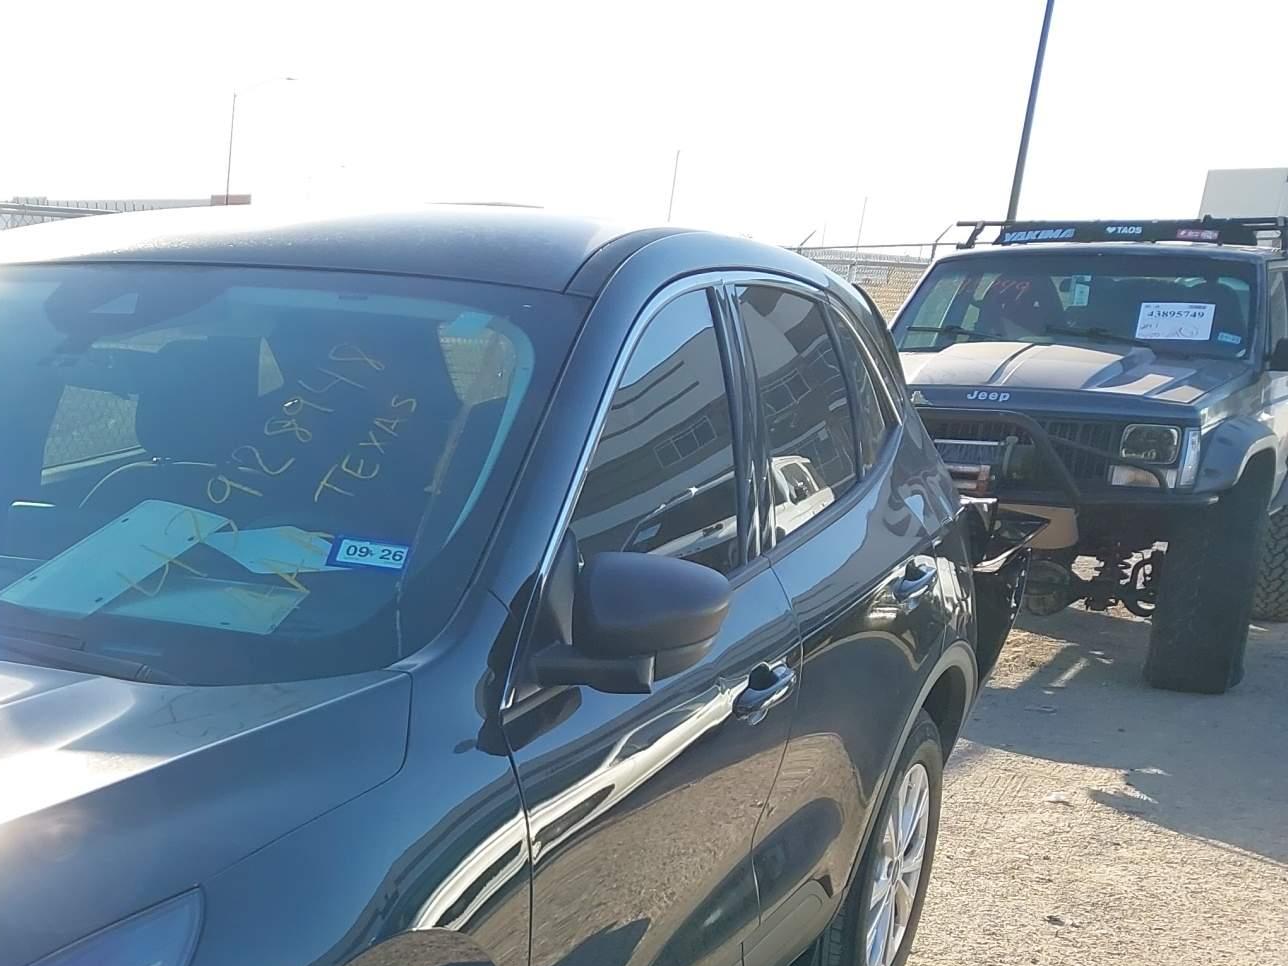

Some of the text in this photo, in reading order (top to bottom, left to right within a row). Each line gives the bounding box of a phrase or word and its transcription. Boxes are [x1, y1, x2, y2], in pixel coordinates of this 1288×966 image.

[1003, 228, 1076, 242] YAKIMA
[1116, 226, 1142, 234] TAOS
[1147, 310, 1205, 319] 43895749
[967, 391, 1010, 402] Jeep
[314, 393, 417, 503] TEXAS
[345, 545, 404, 562] 09 26
